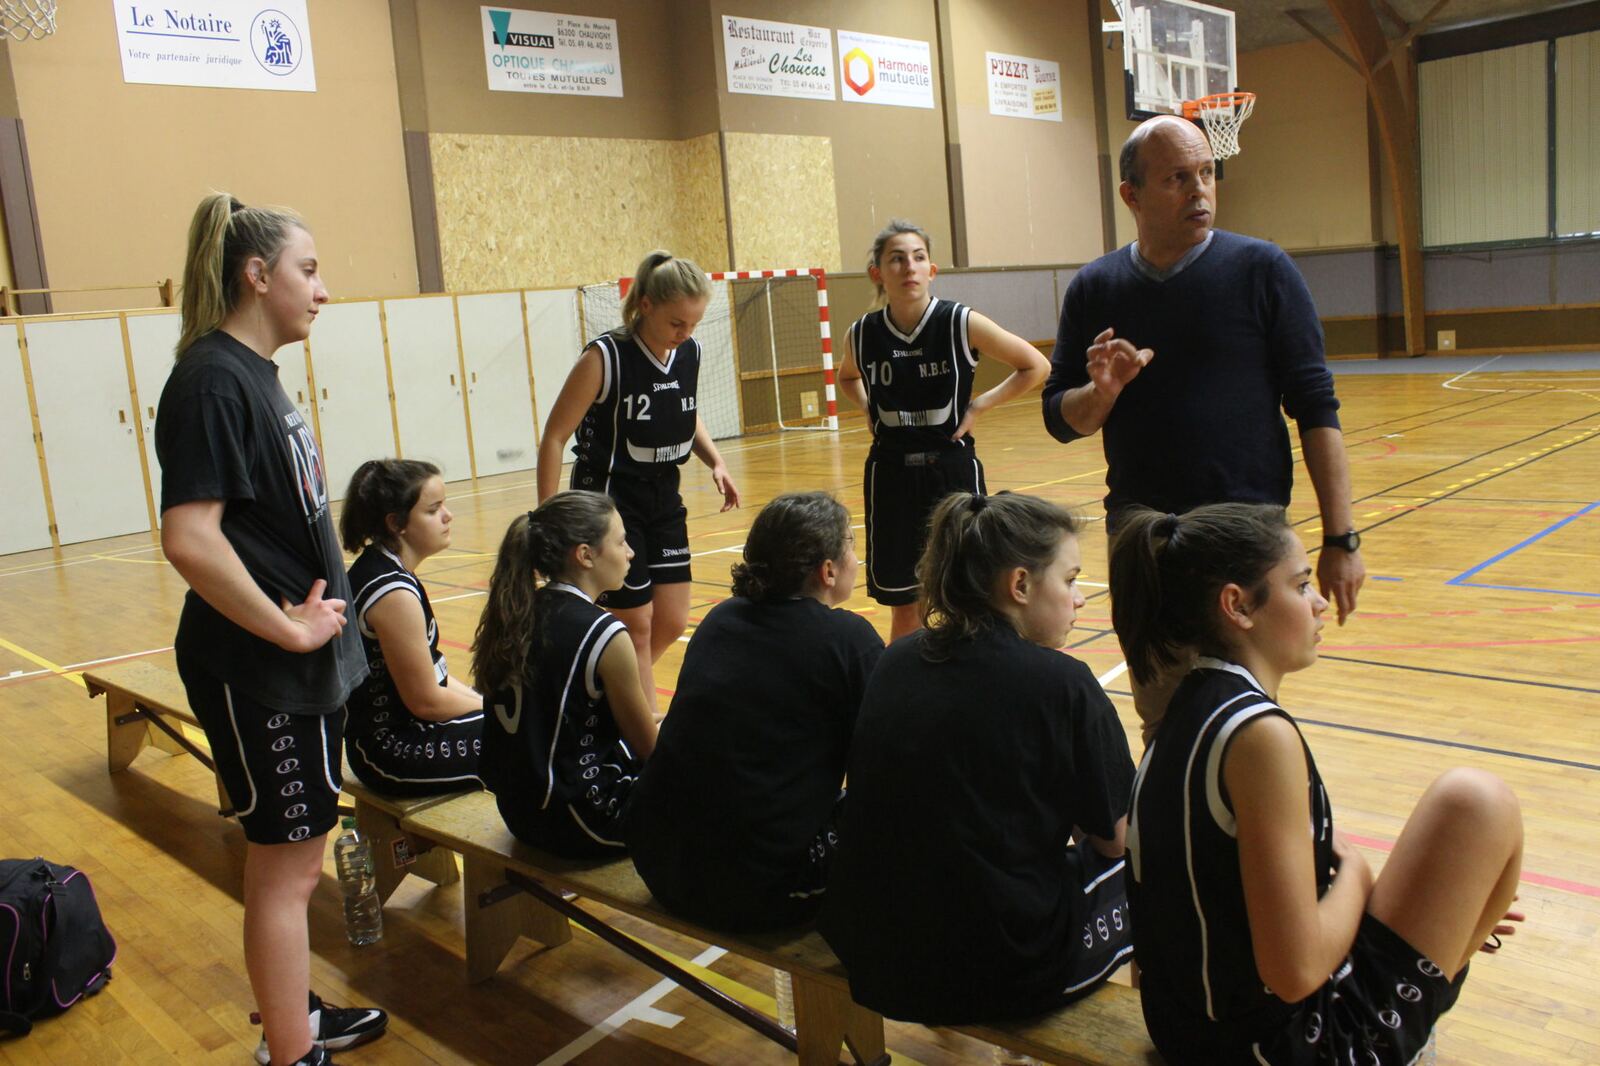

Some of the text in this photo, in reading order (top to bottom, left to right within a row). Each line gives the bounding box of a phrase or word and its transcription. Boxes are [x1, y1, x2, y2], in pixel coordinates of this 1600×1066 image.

[131, 6, 232, 34] Le Notaire
[728, 19, 795, 45] Restaurant
[509, 34, 553, 48] VISUAL
[129, 49, 243, 66] Votre partenaire juridique
[492, 54, 545, 70] OPTIQUE
[793, 47, 813, 63] Les
[768, 52, 827, 77] Choucas
[878, 57, 928, 75] Harmonie
[991, 58, 1029, 80] PIZZA
[507, 71, 607, 86] TOUTES MUTUELLES
[879, 71, 929, 87] mutuelle
[892, 348, 923, 358] SPALDING
[867, 361, 893, 386] 10
[653, 380, 680, 392] SPALDING
[624, 394, 651, 421] 12
